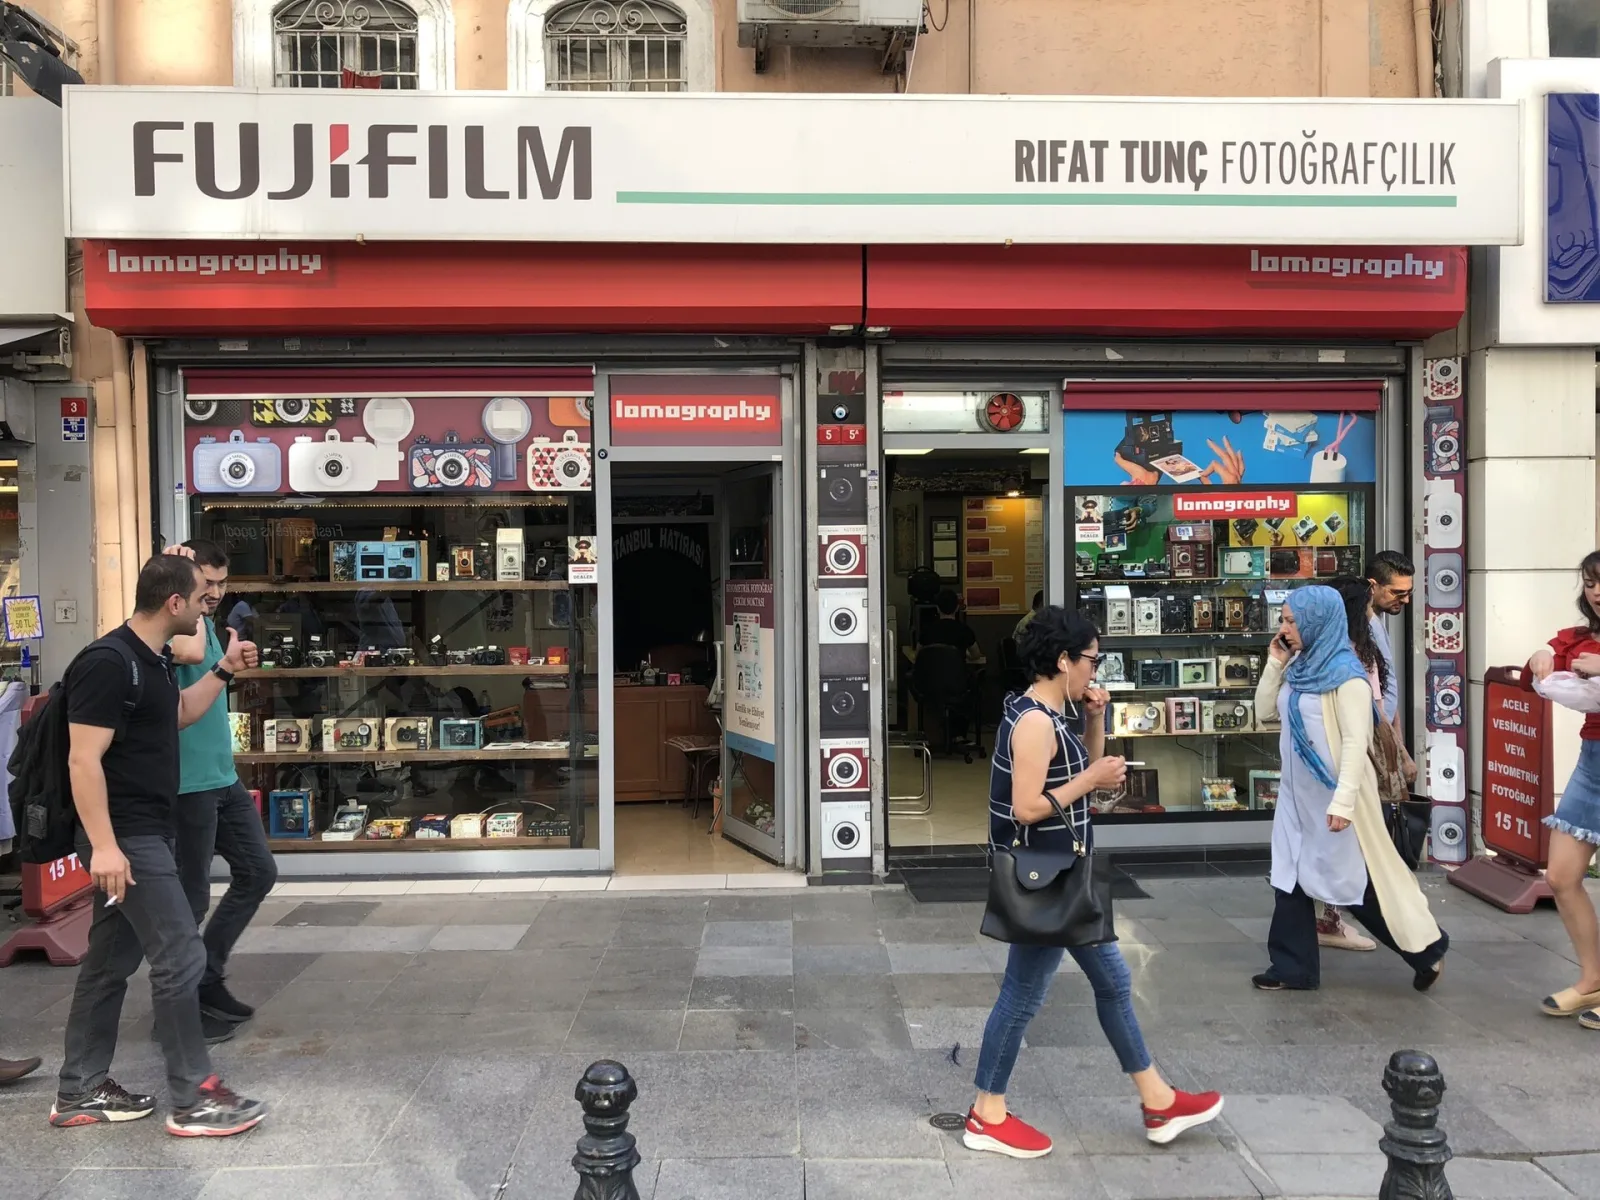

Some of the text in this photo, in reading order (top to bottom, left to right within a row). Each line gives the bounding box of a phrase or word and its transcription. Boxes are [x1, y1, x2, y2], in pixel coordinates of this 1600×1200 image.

[133, 121, 593, 201] FUJIFILM
[1015, 129, 1457, 192] RIFAT TUNÇ FOTOĞRAFÇILIK
[107, 248, 322, 275] lomography
[1250, 249, 1444, 279] lomography
[70, 402, 78, 413] 3
[616, 400, 771, 421] lomography
[825, 429, 833, 440] 5
[849, 429, 860, 440] 5A
[1176, 496, 1290, 512] lomography
[611, 527, 654, 561] TANBUL
[1502, 698, 1530, 713] ACELE
[1492, 718, 1537, 738] VESİKALIK
[1504, 742, 1526, 758] VEYA
[1488, 760, 1539, 785] BİYOMETRİK
[1491, 783, 1536, 807] FOTOĞRAF
[1494, 811, 1532, 839] 15 TL
[49, 857, 66, 881] 15
